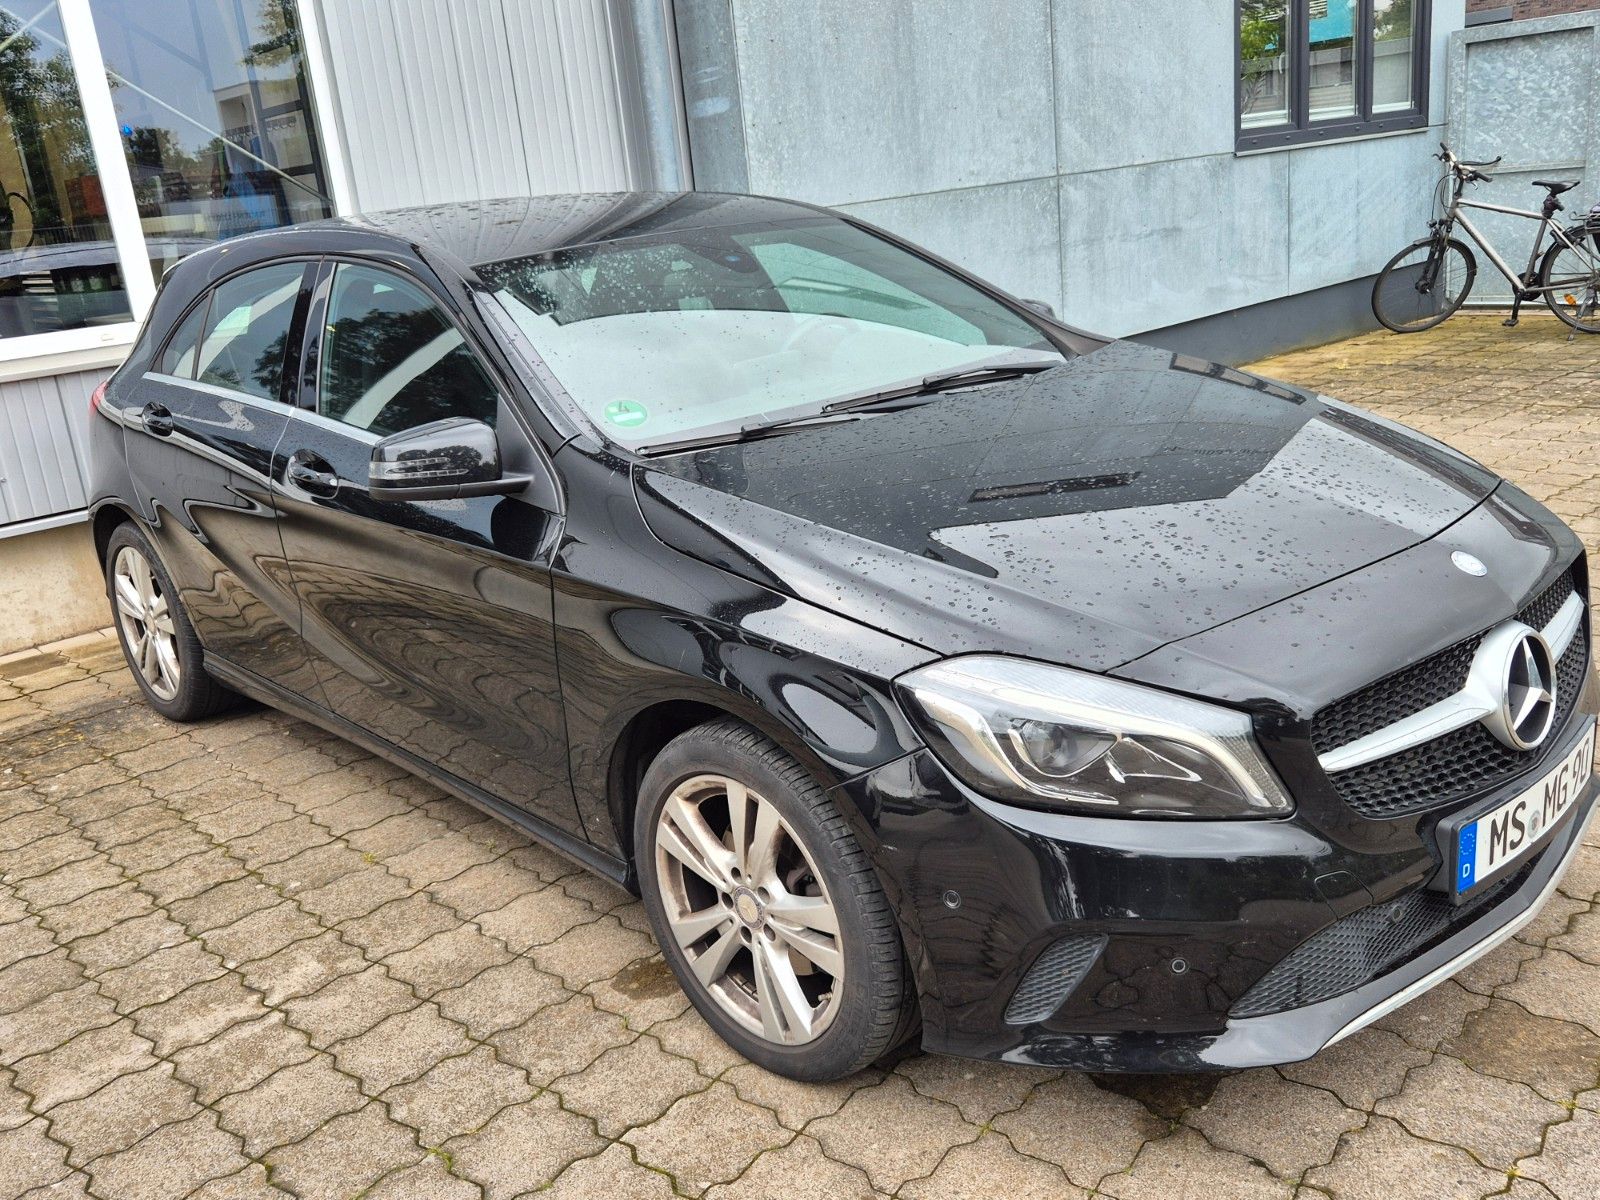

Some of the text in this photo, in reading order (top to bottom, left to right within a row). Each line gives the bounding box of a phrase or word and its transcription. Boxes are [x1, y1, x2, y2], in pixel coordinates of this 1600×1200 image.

[1489, 801, 1527, 866] MS
[1542, 763, 1569, 828] MG
[1462, 863, 1471, 879] D
